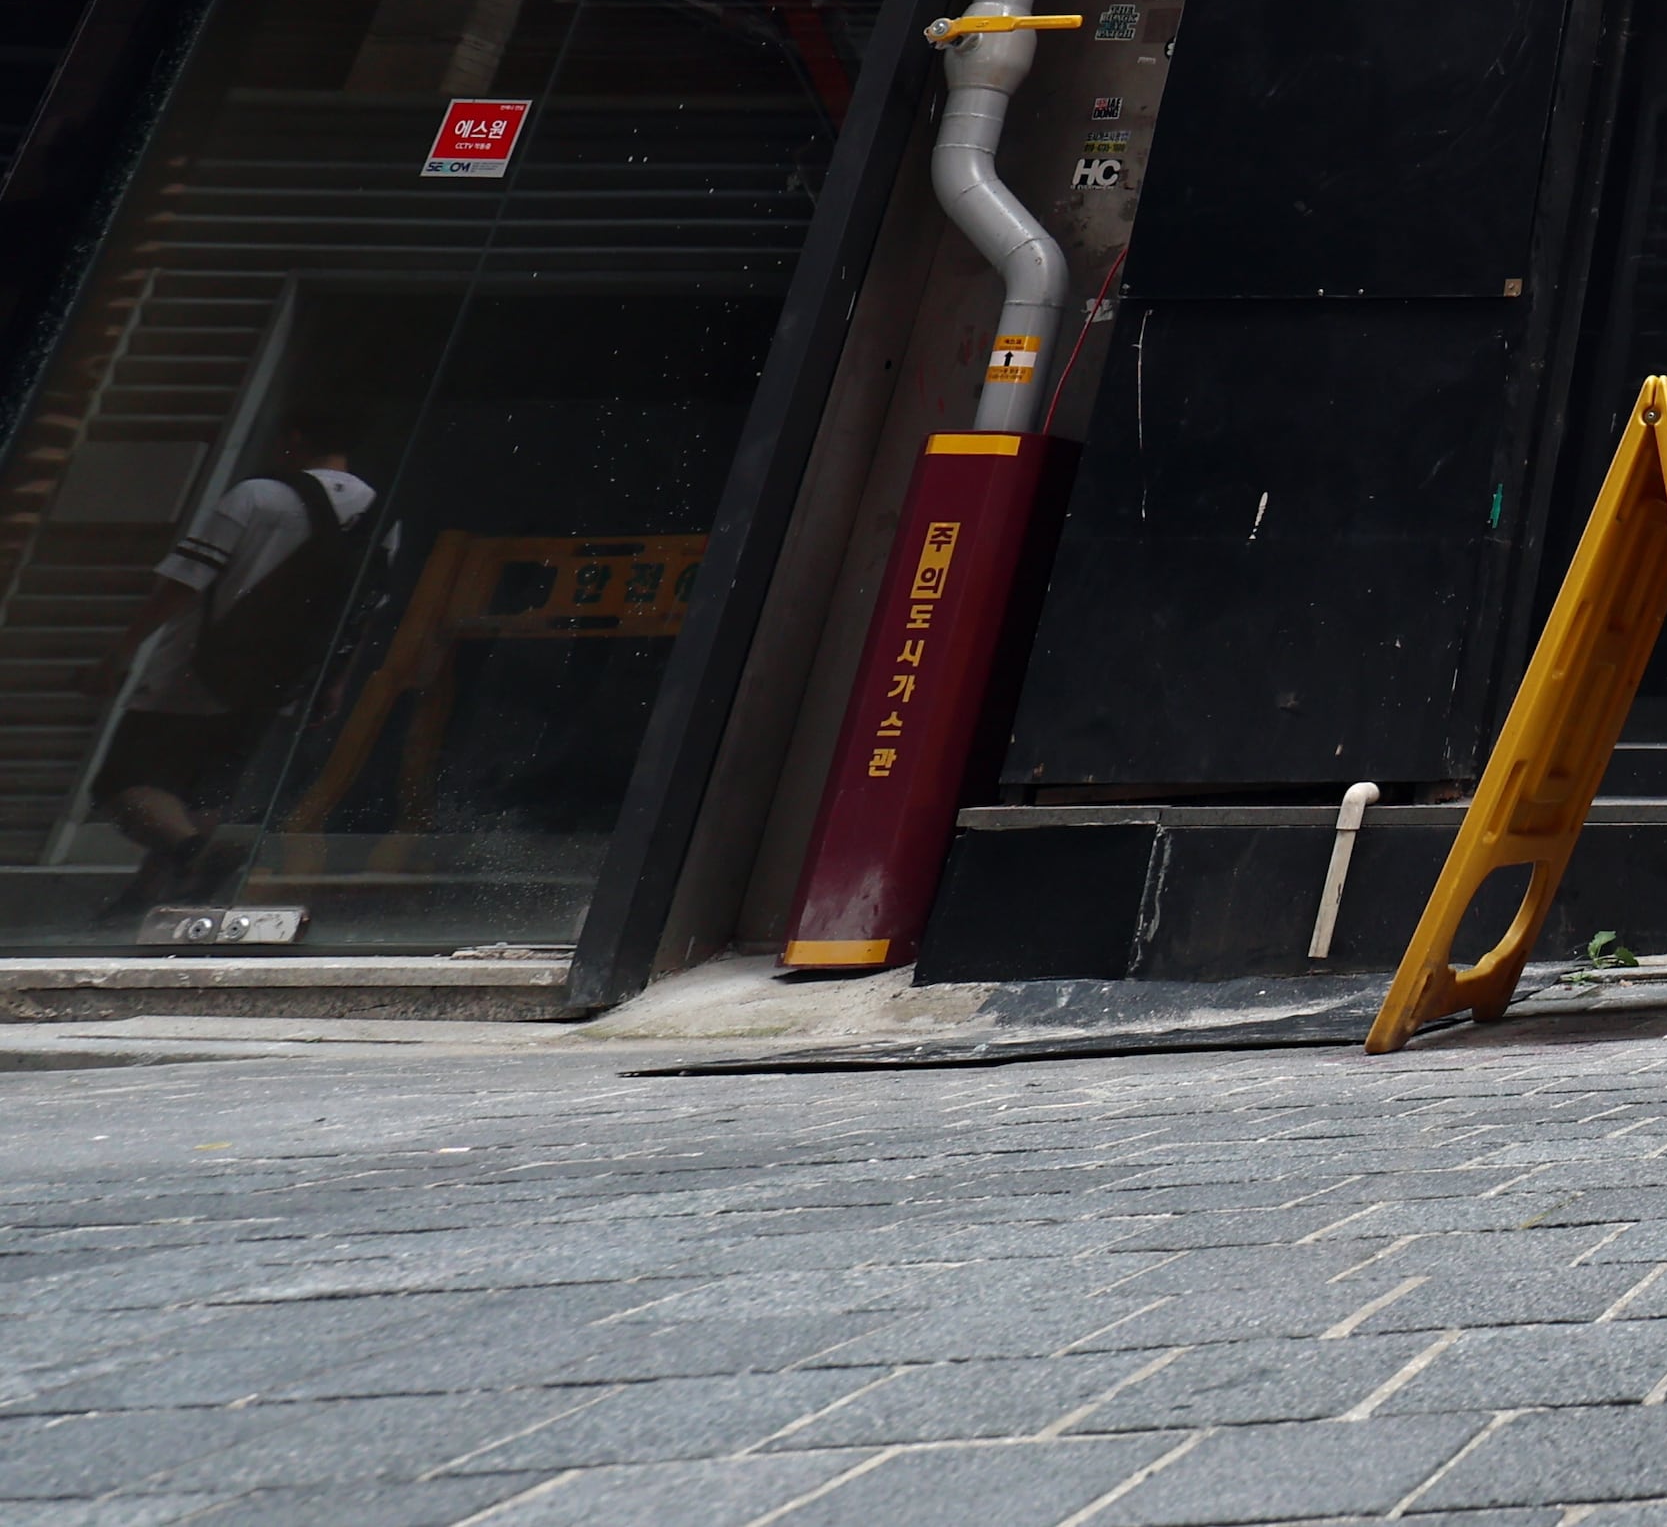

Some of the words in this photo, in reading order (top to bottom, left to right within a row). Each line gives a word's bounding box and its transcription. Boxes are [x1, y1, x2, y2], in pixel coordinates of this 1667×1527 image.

[454, 119, 508, 139] 에스원
[455, 142, 473, 150] CCTV
[426, 161, 472, 173] SECOM
[1071, 158, 1121, 187] HC
[916, 524, 957, 595] 주의
[867, 604, 933, 778] 도시가스관
